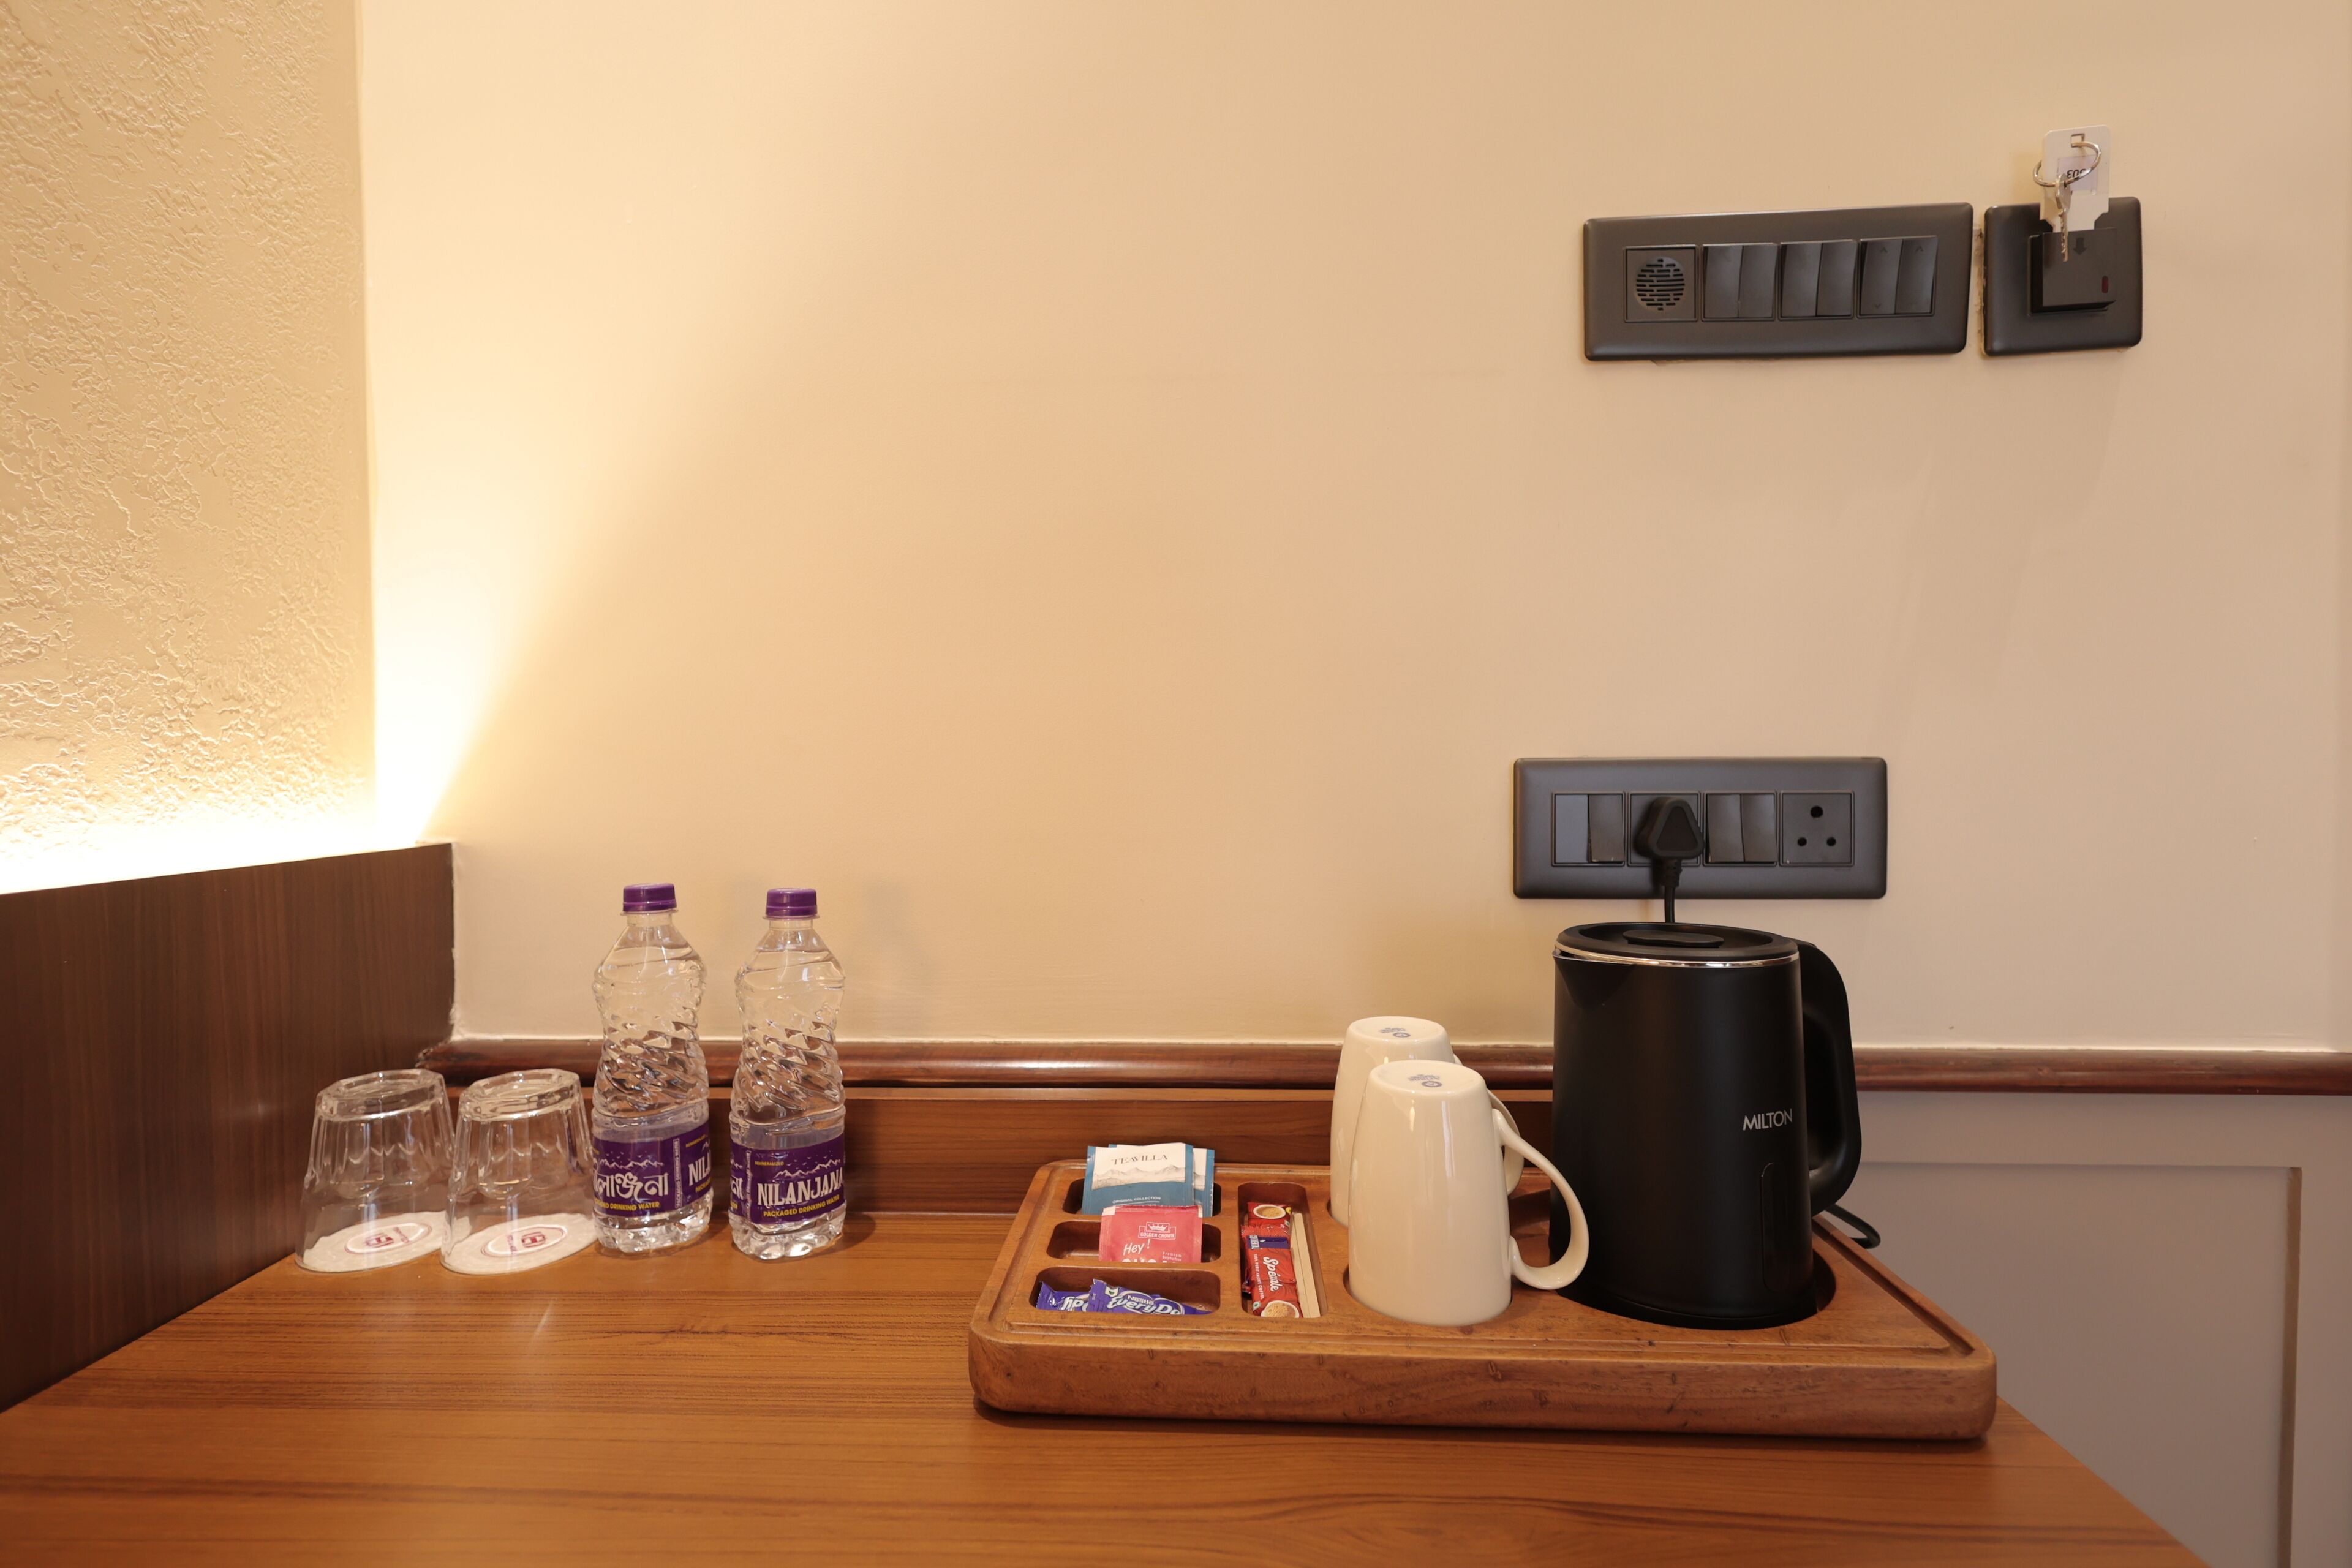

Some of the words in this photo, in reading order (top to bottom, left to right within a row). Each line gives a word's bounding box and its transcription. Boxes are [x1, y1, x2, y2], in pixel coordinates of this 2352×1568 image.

[1742, 1108, 1793, 1131] MILTON
[1111, 1154, 1168, 1165] TEAVILLA
[757, 1167, 843, 1206] NILANJANA
[638, 1201, 660, 1210] WATER
[763, 1208, 797, 1217] PACKAGED
[798, 1201, 826, 1213] DRINKING
[826, 1194, 840, 1205] WATER
